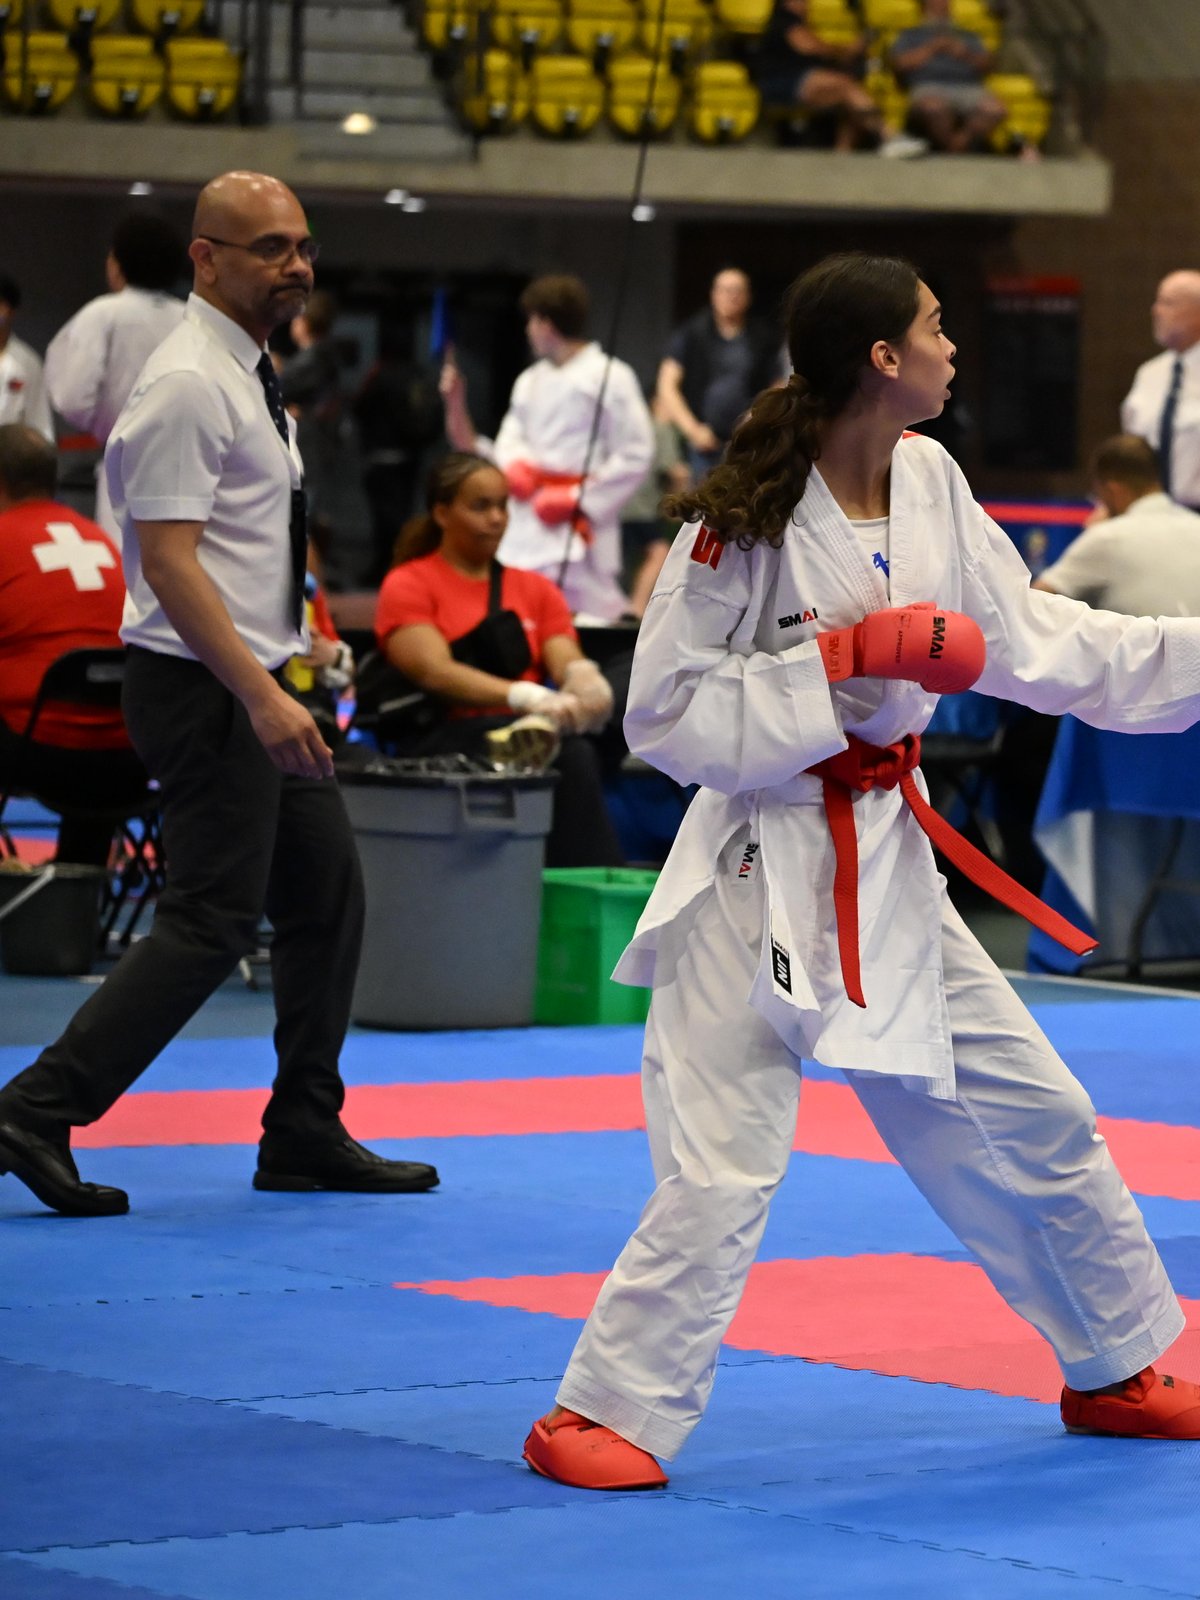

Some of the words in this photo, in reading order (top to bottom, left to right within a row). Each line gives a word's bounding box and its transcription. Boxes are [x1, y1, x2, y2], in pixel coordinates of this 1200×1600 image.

[777, 607, 819, 629] SMAI
[929, 615, 946, 660] SMAI
[776, 952, 790, 986] JIN
